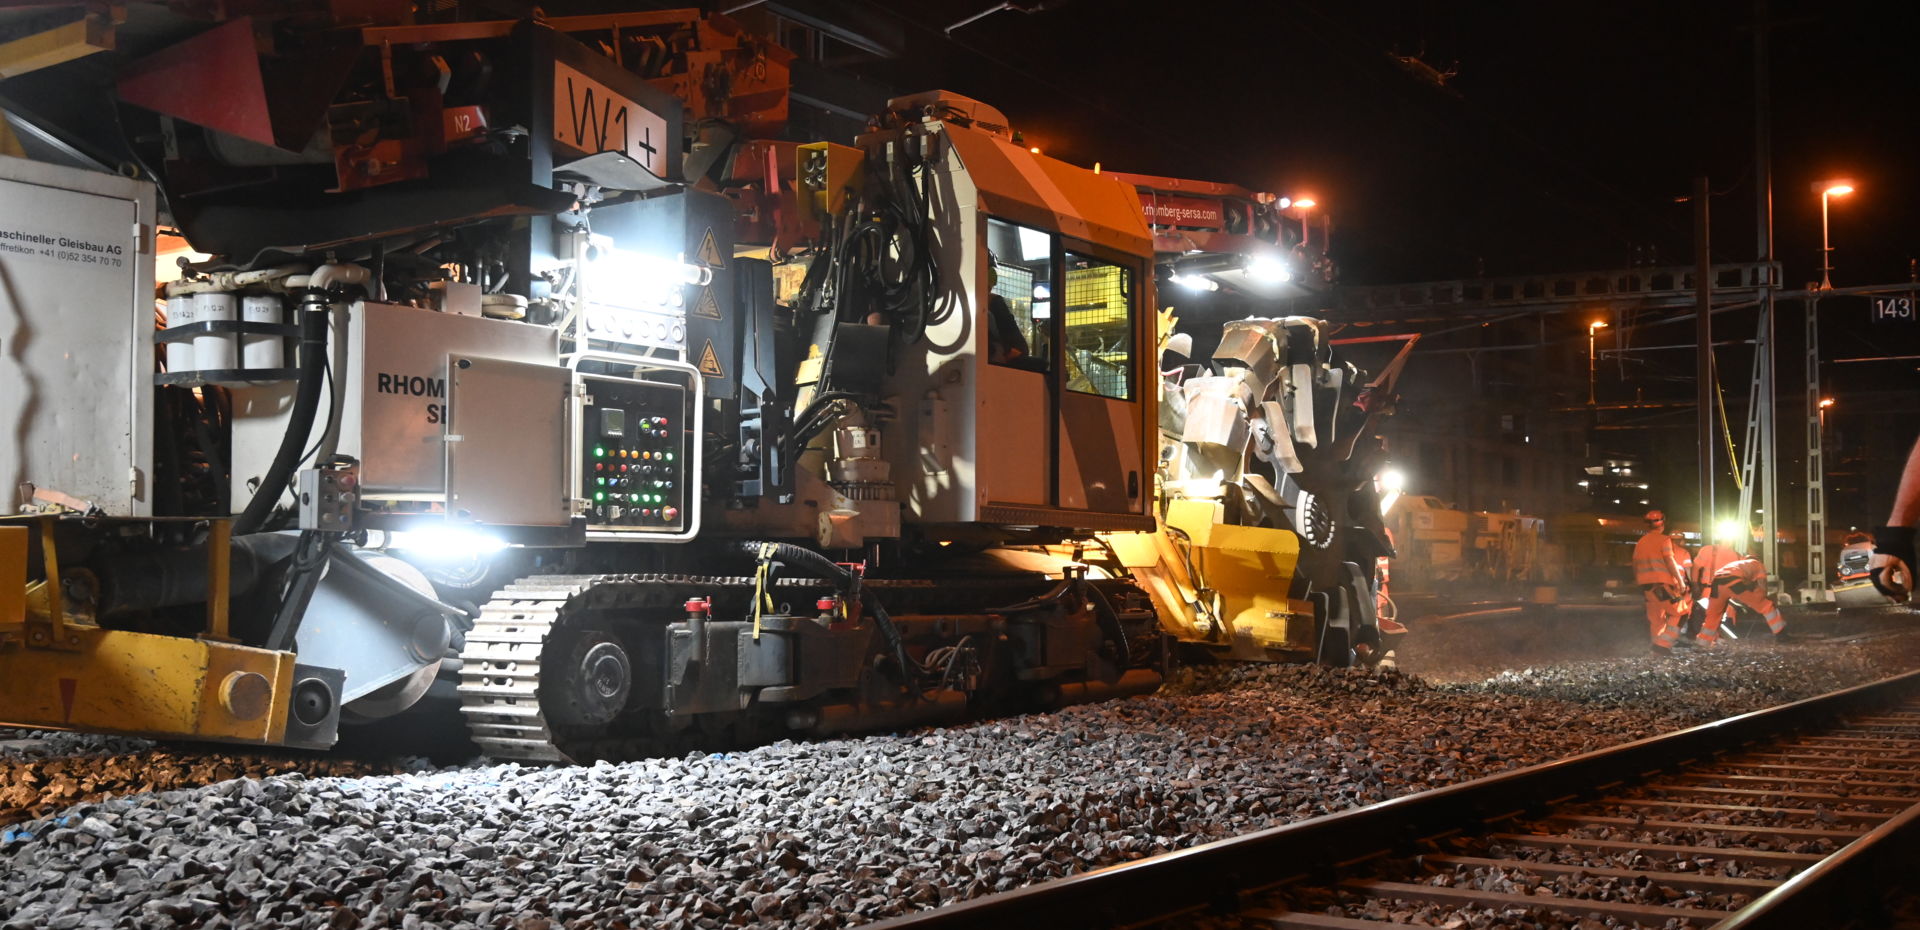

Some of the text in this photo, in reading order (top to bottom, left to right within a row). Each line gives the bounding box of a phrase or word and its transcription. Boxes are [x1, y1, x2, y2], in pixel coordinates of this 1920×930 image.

[454, 114, 471, 134] N2
[1142, 203, 1217, 221] .rhomberg-sersa.com
[58, 237, 104, 253] Gleisbau
[106, 244, 122, 255] AG
[40, 248, 55, 257] +41
[57, 250, 80, 262] (0)52
[81, 253, 97, 263] 354
[99, 256, 110, 266] 70
[112, 257, 122, 268] 70
[1876, 298, 1910, 319] 143
[377, 372, 445, 399] RHOM
